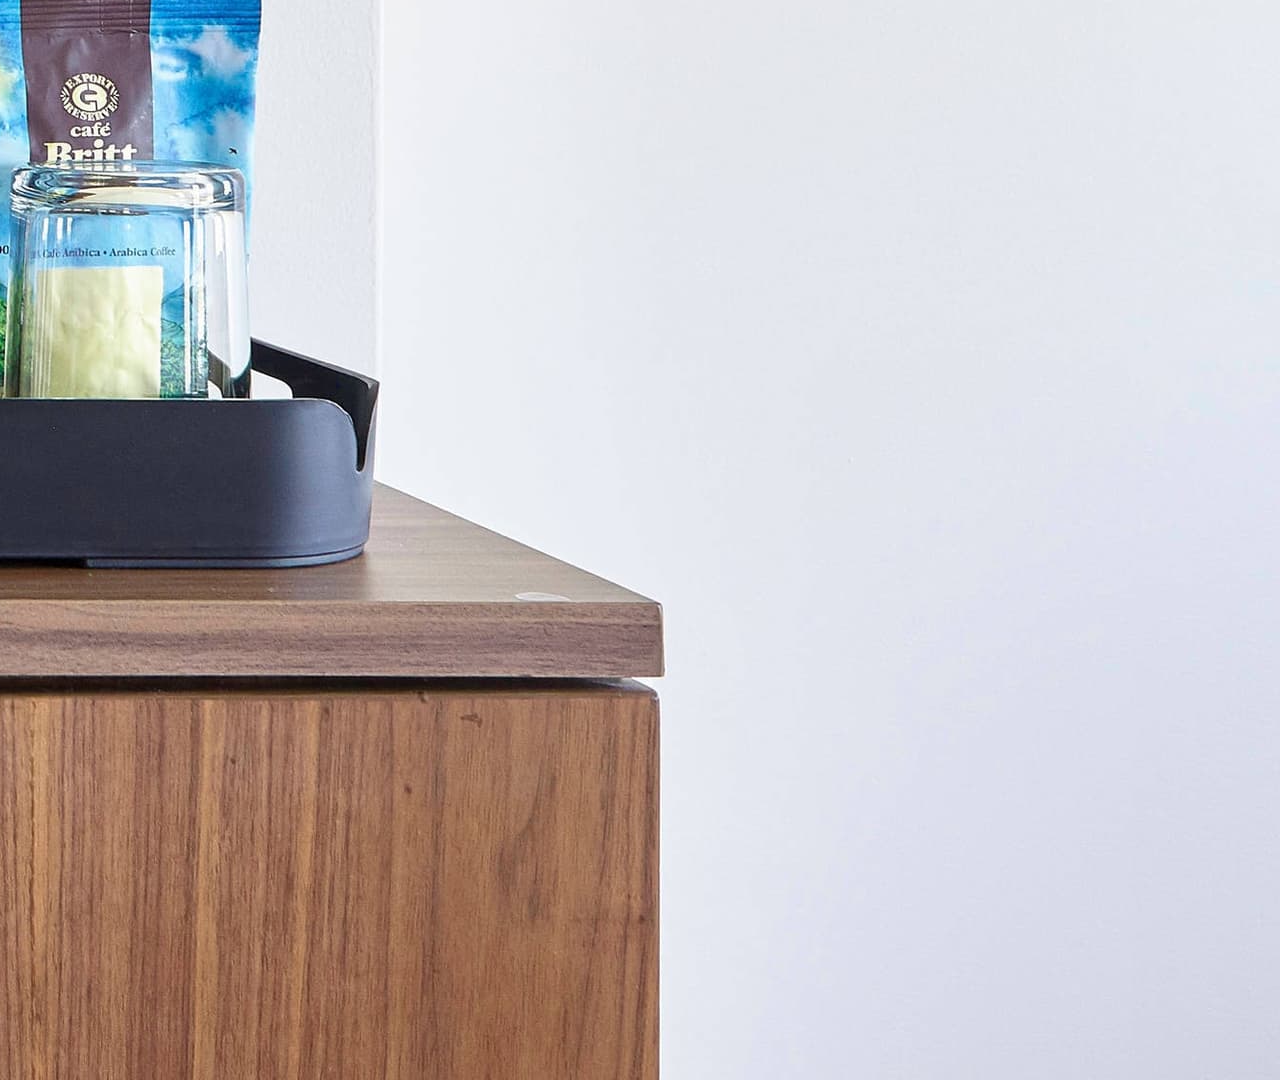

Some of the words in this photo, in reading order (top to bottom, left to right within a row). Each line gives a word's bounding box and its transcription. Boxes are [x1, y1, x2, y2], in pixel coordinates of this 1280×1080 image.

[65, 73, 115, 89] EXPORT
[64, 102, 118, 121] RESERVE
[70, 122, 111, 137] café
[44, 139, 137, 170] Britt
[109, 247, 148, 257] Arabica
[150, 246, 176, 257] Coffee
